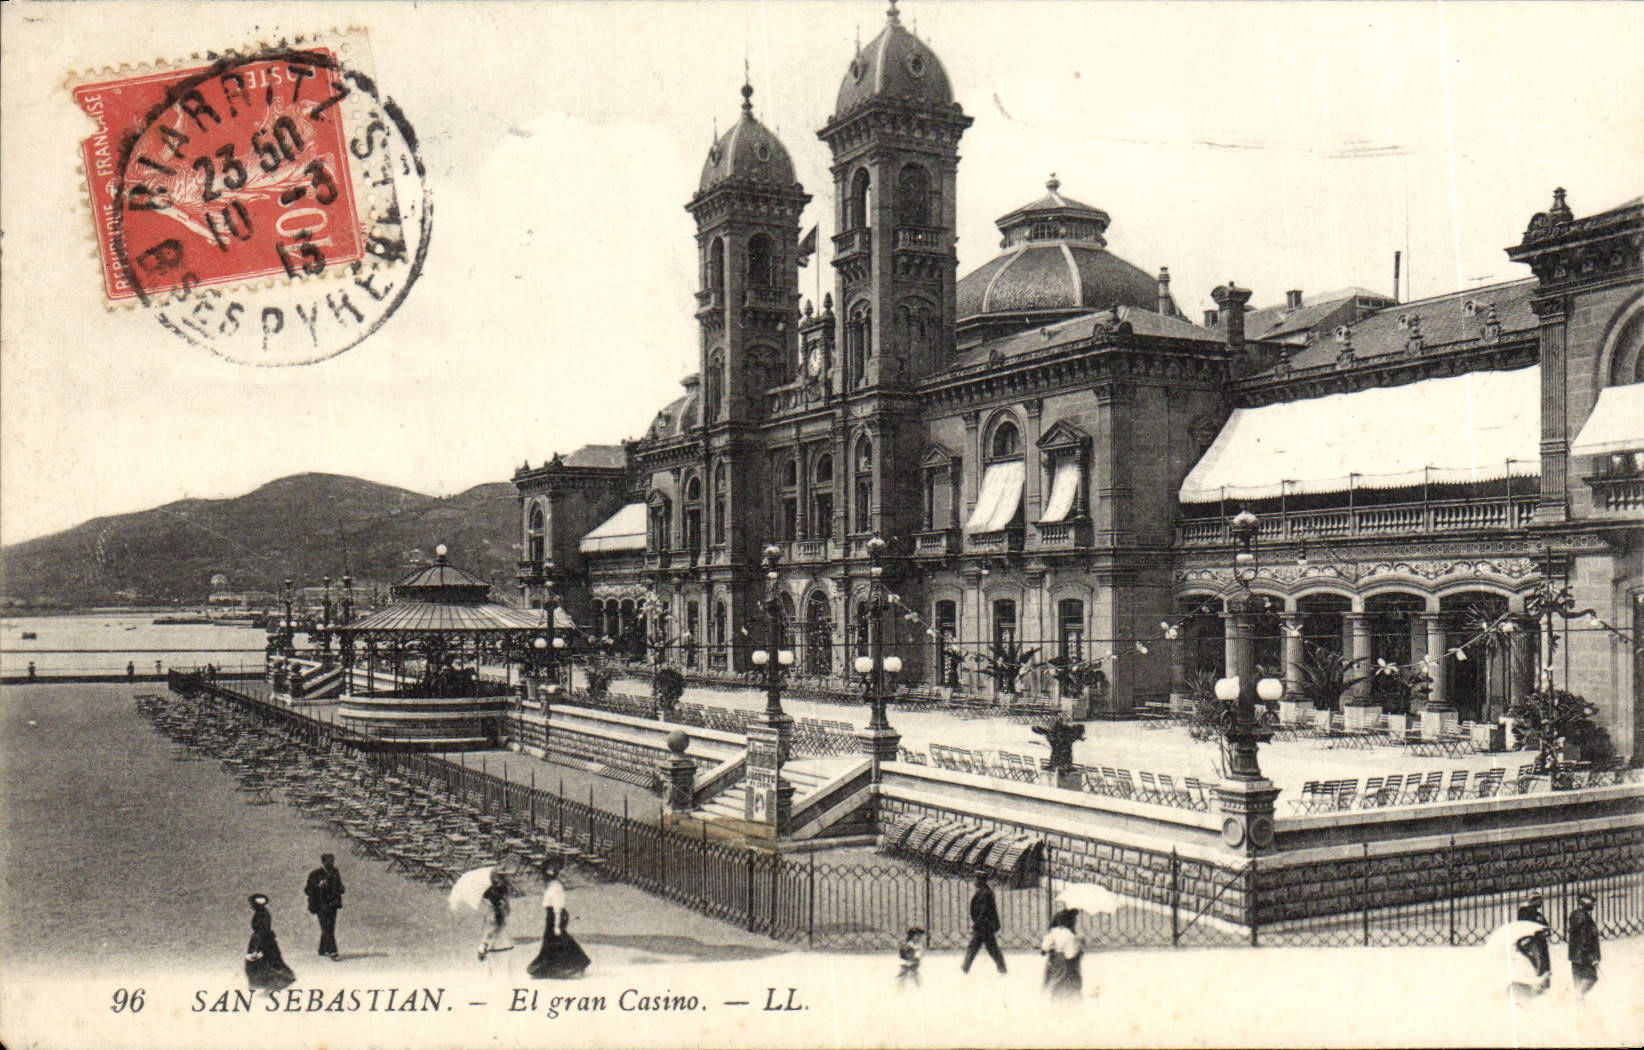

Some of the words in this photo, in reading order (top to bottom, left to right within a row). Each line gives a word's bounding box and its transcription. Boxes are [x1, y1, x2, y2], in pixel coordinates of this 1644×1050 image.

[128, 65, 351, 213] BIARRITZ
[193, 143, 248, 202] 23
[205, 200, 255, 252] 10
